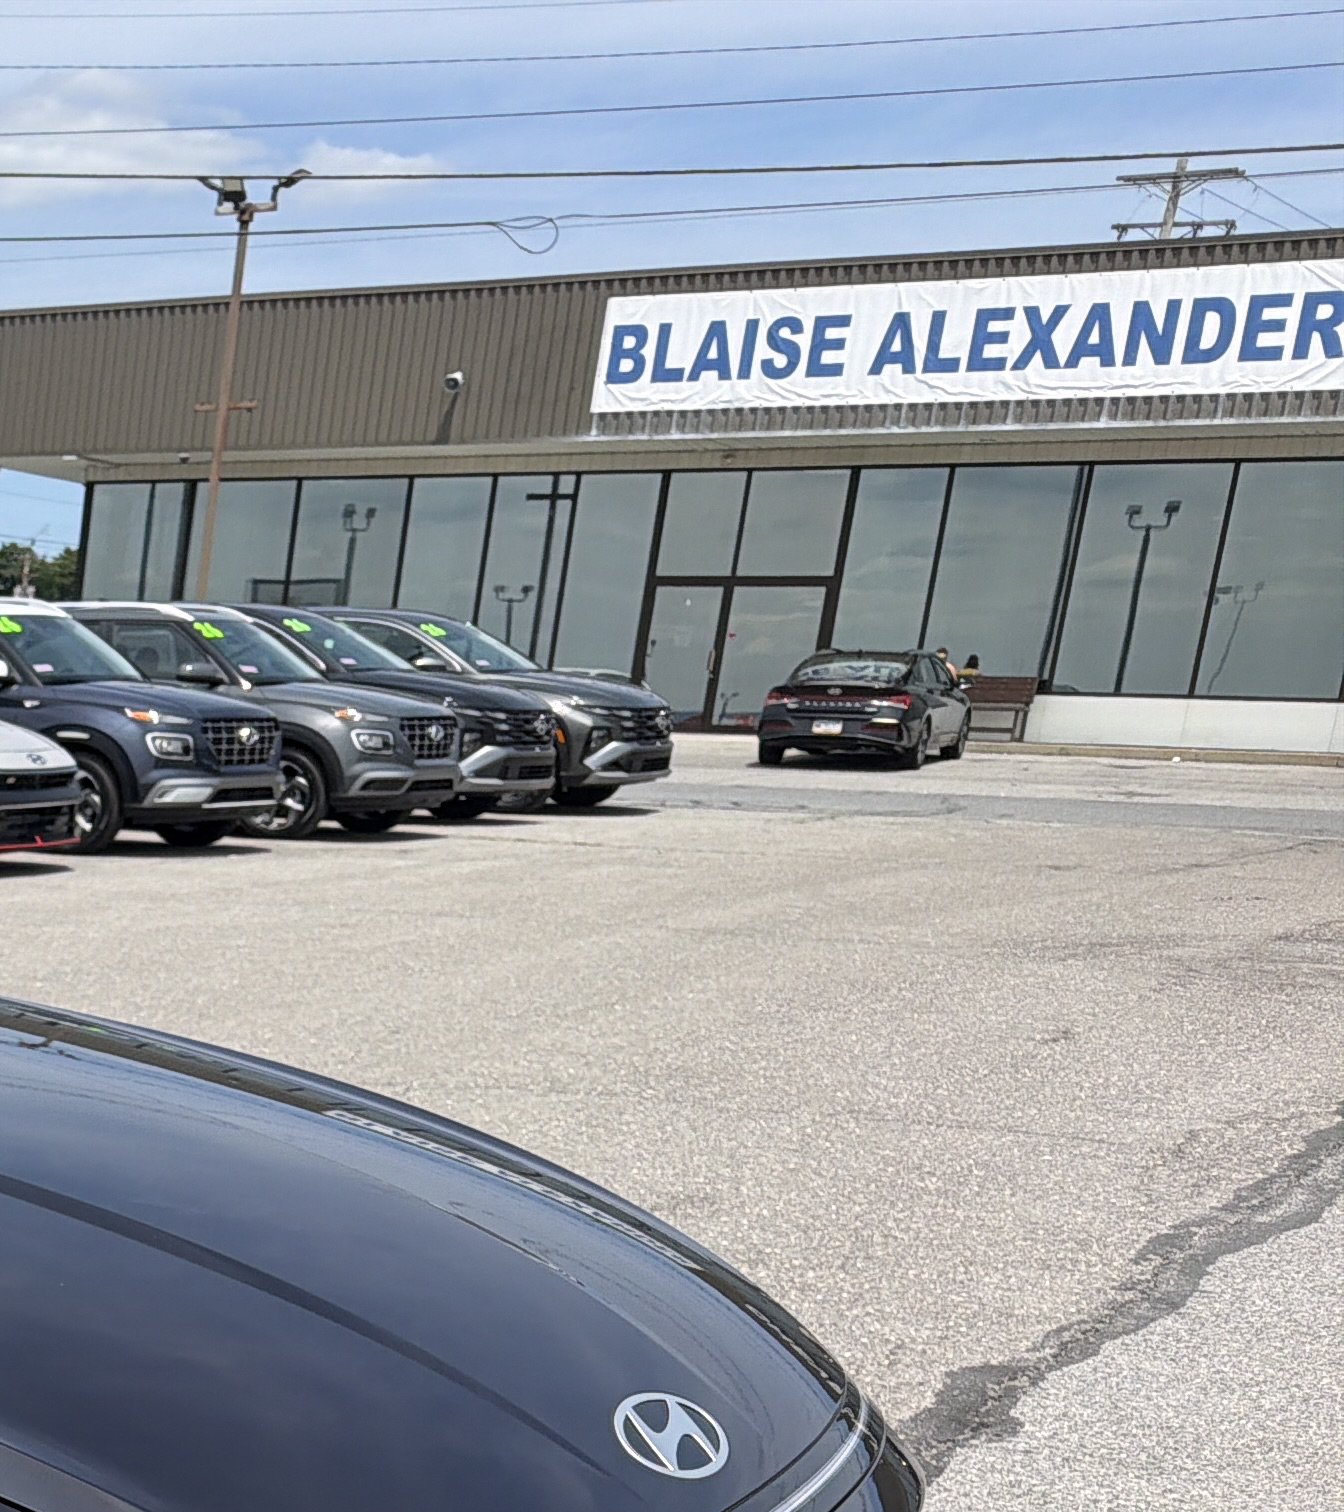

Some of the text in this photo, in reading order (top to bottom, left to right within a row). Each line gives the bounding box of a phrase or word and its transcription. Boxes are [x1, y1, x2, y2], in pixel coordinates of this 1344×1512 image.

[604, 290, 1344, 384] BLAISE ALEXANDER
[193, 622, 224, 638] 26
